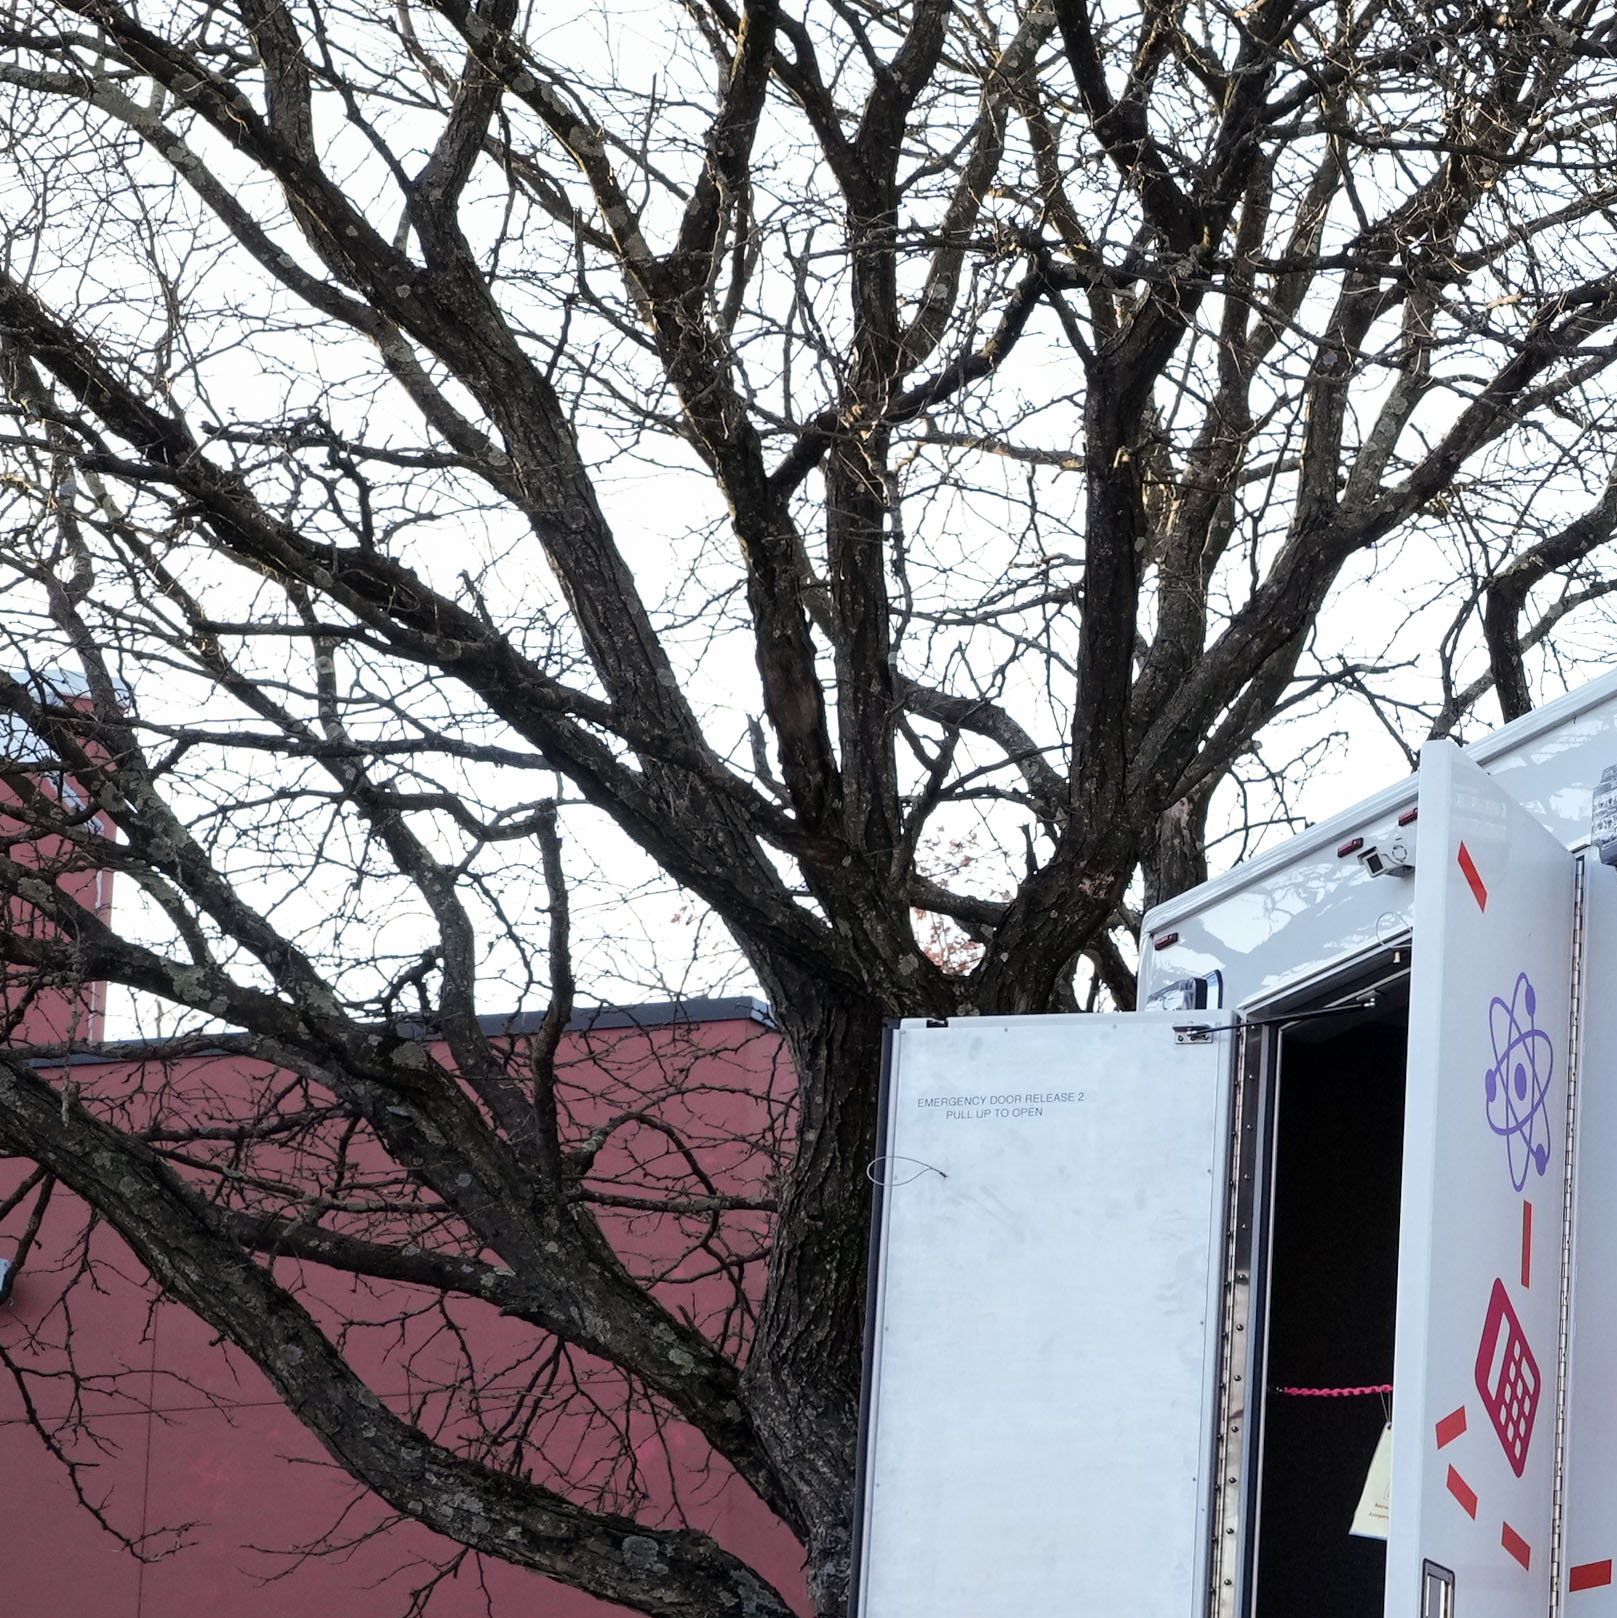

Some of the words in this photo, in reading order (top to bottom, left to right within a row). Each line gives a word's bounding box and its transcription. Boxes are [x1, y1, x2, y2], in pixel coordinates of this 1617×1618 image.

[917, 1095, 987, 1108] EMERGENCY
[989, 1094, 1022, 1105] DOOR
[1025, 1093, 1074, 1104] RELEASE
[1078, 1092, 1085, 1102] 2
[946, 1110, 973, 1120] PULL
[975, 1109, 991, 1119] UP
[994, 1108, 1009, 1118] TO
[1011, 1108, 1043, 1118] OPEN
